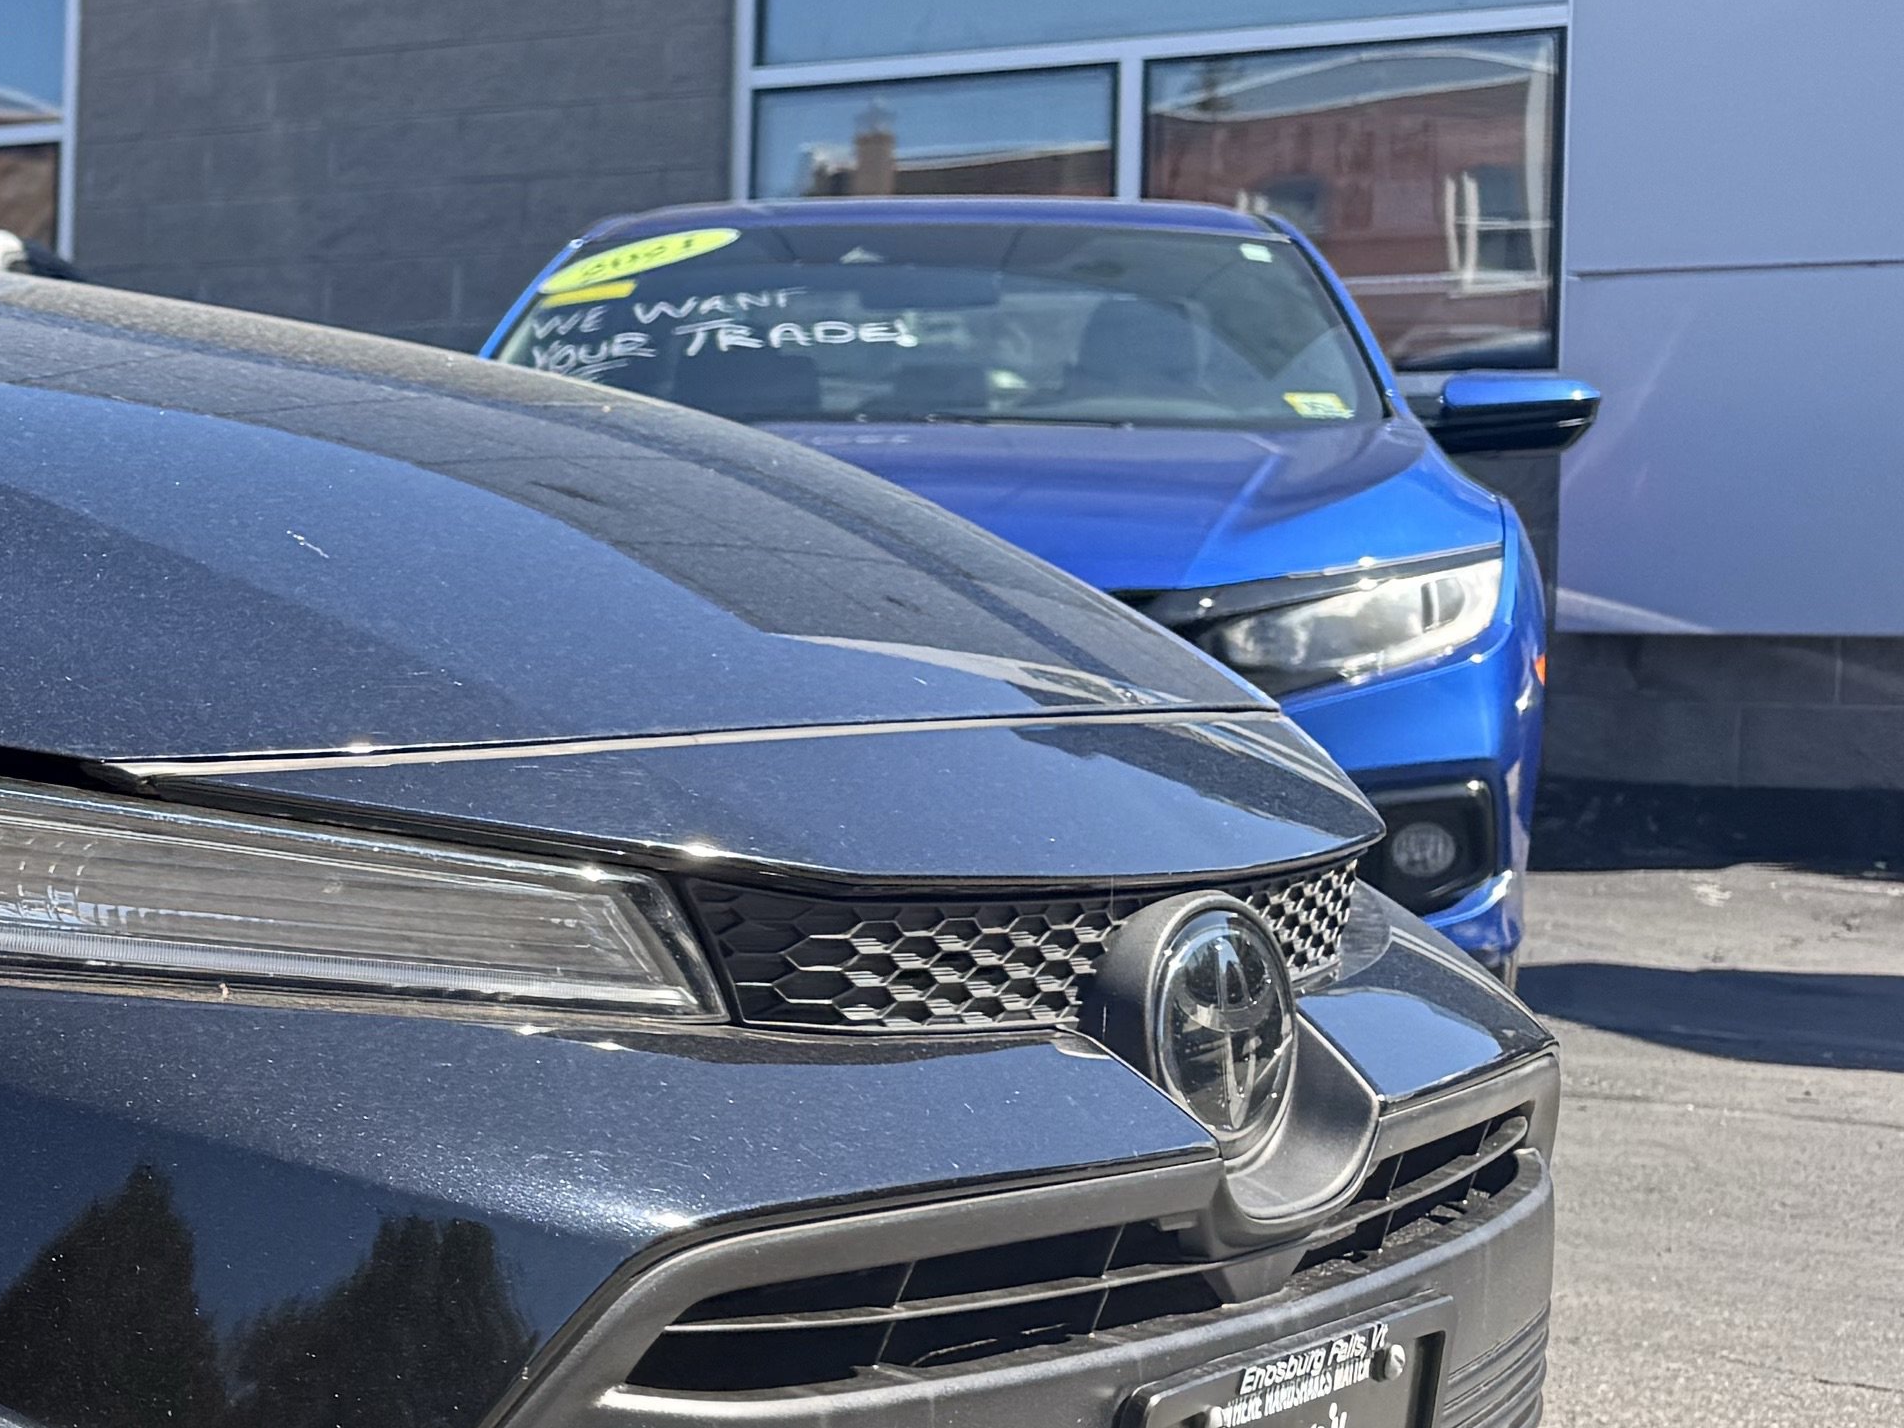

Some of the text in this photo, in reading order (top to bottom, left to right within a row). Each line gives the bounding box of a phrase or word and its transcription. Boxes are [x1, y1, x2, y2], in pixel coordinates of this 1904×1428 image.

[530, 286, 808, 341] WE WANT
[531, 317, 919, 374] YOUR TRADE!
[1239, 1321, 1389, 1395] Enosburg Falls, Vt
